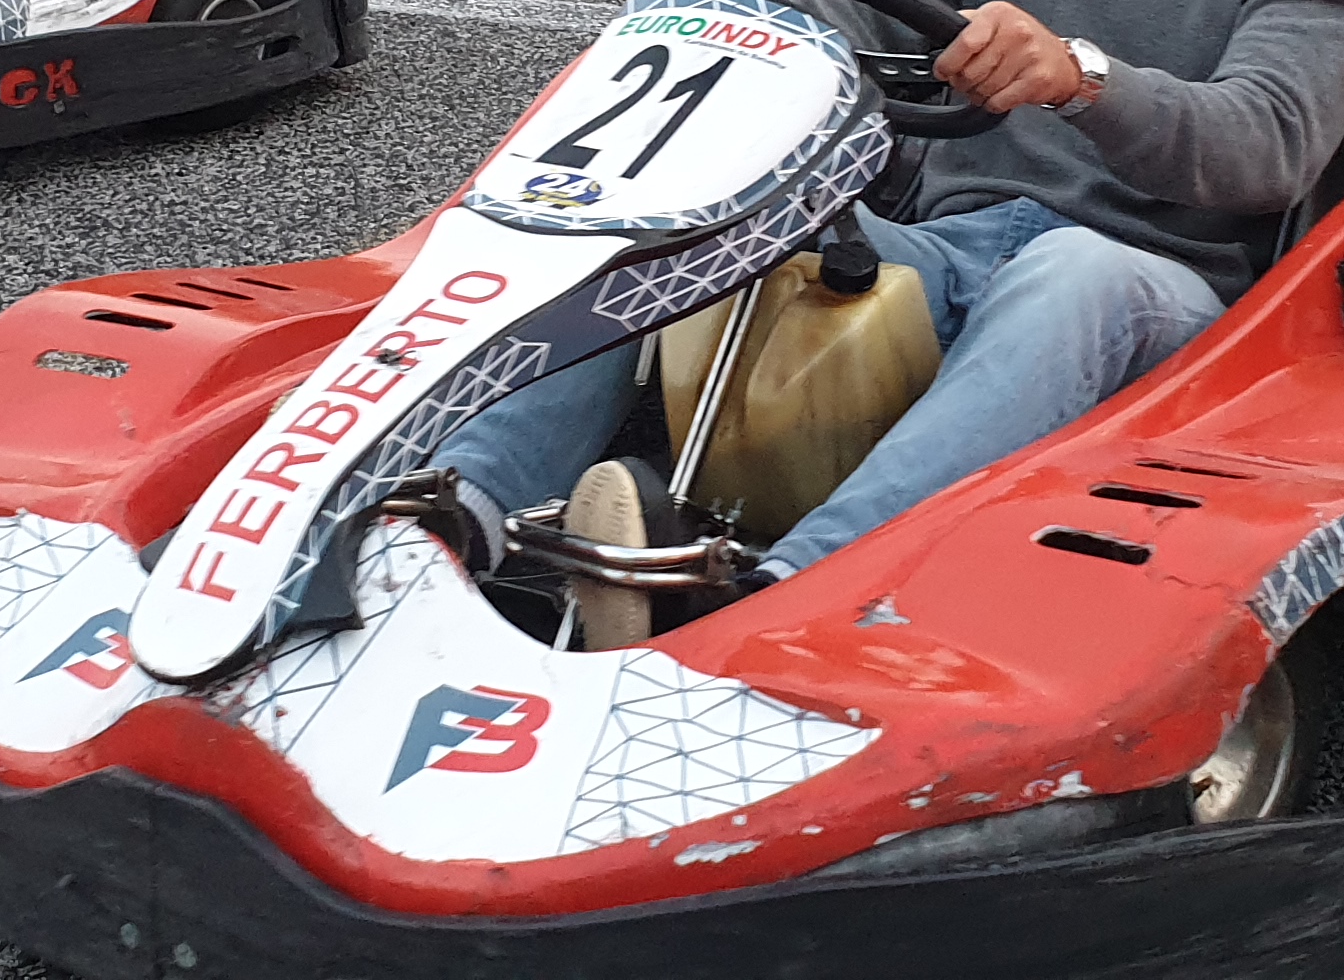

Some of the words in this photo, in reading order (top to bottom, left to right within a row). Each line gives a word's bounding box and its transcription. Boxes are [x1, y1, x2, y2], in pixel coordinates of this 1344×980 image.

[615, 14, 800, 57] EUROINDY
[533, 43, 735, 179] 21
[179, 269, 508, 602] FERBERTO
